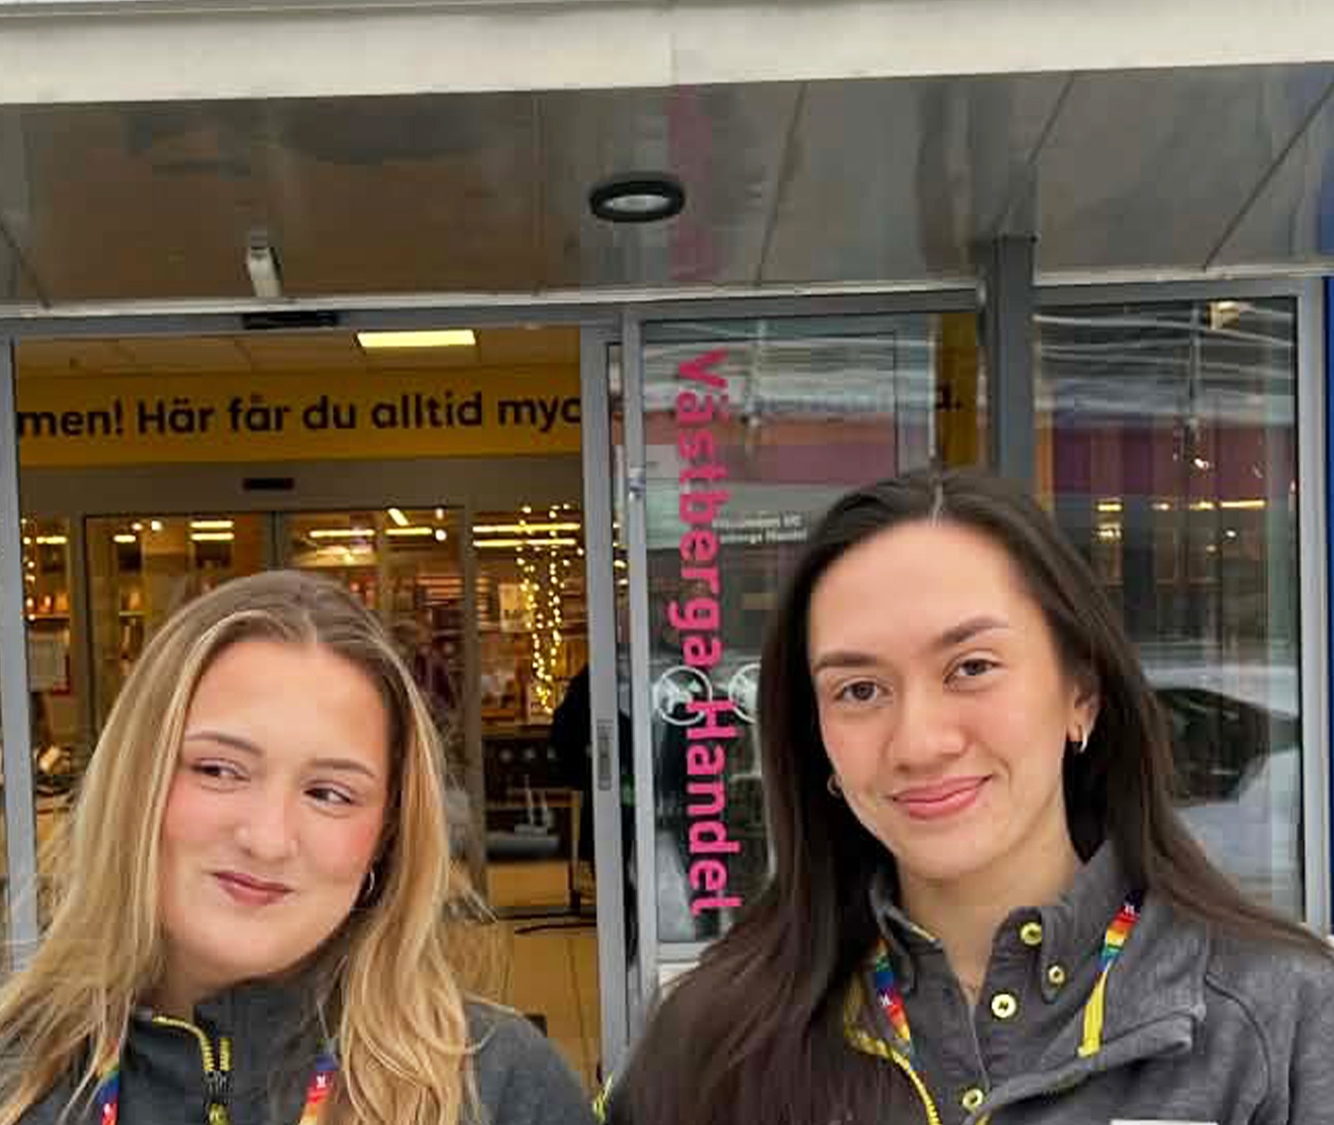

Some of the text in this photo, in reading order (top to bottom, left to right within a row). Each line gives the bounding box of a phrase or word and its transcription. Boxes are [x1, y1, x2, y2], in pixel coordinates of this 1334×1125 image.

[137, 397, 215, 434] Här
[227, 394, 290, 432] får
[302, 396, 357, 430] du
[371, 390, 483, 429] alltid
[667, 347, 744, 917] Västberga Handel
